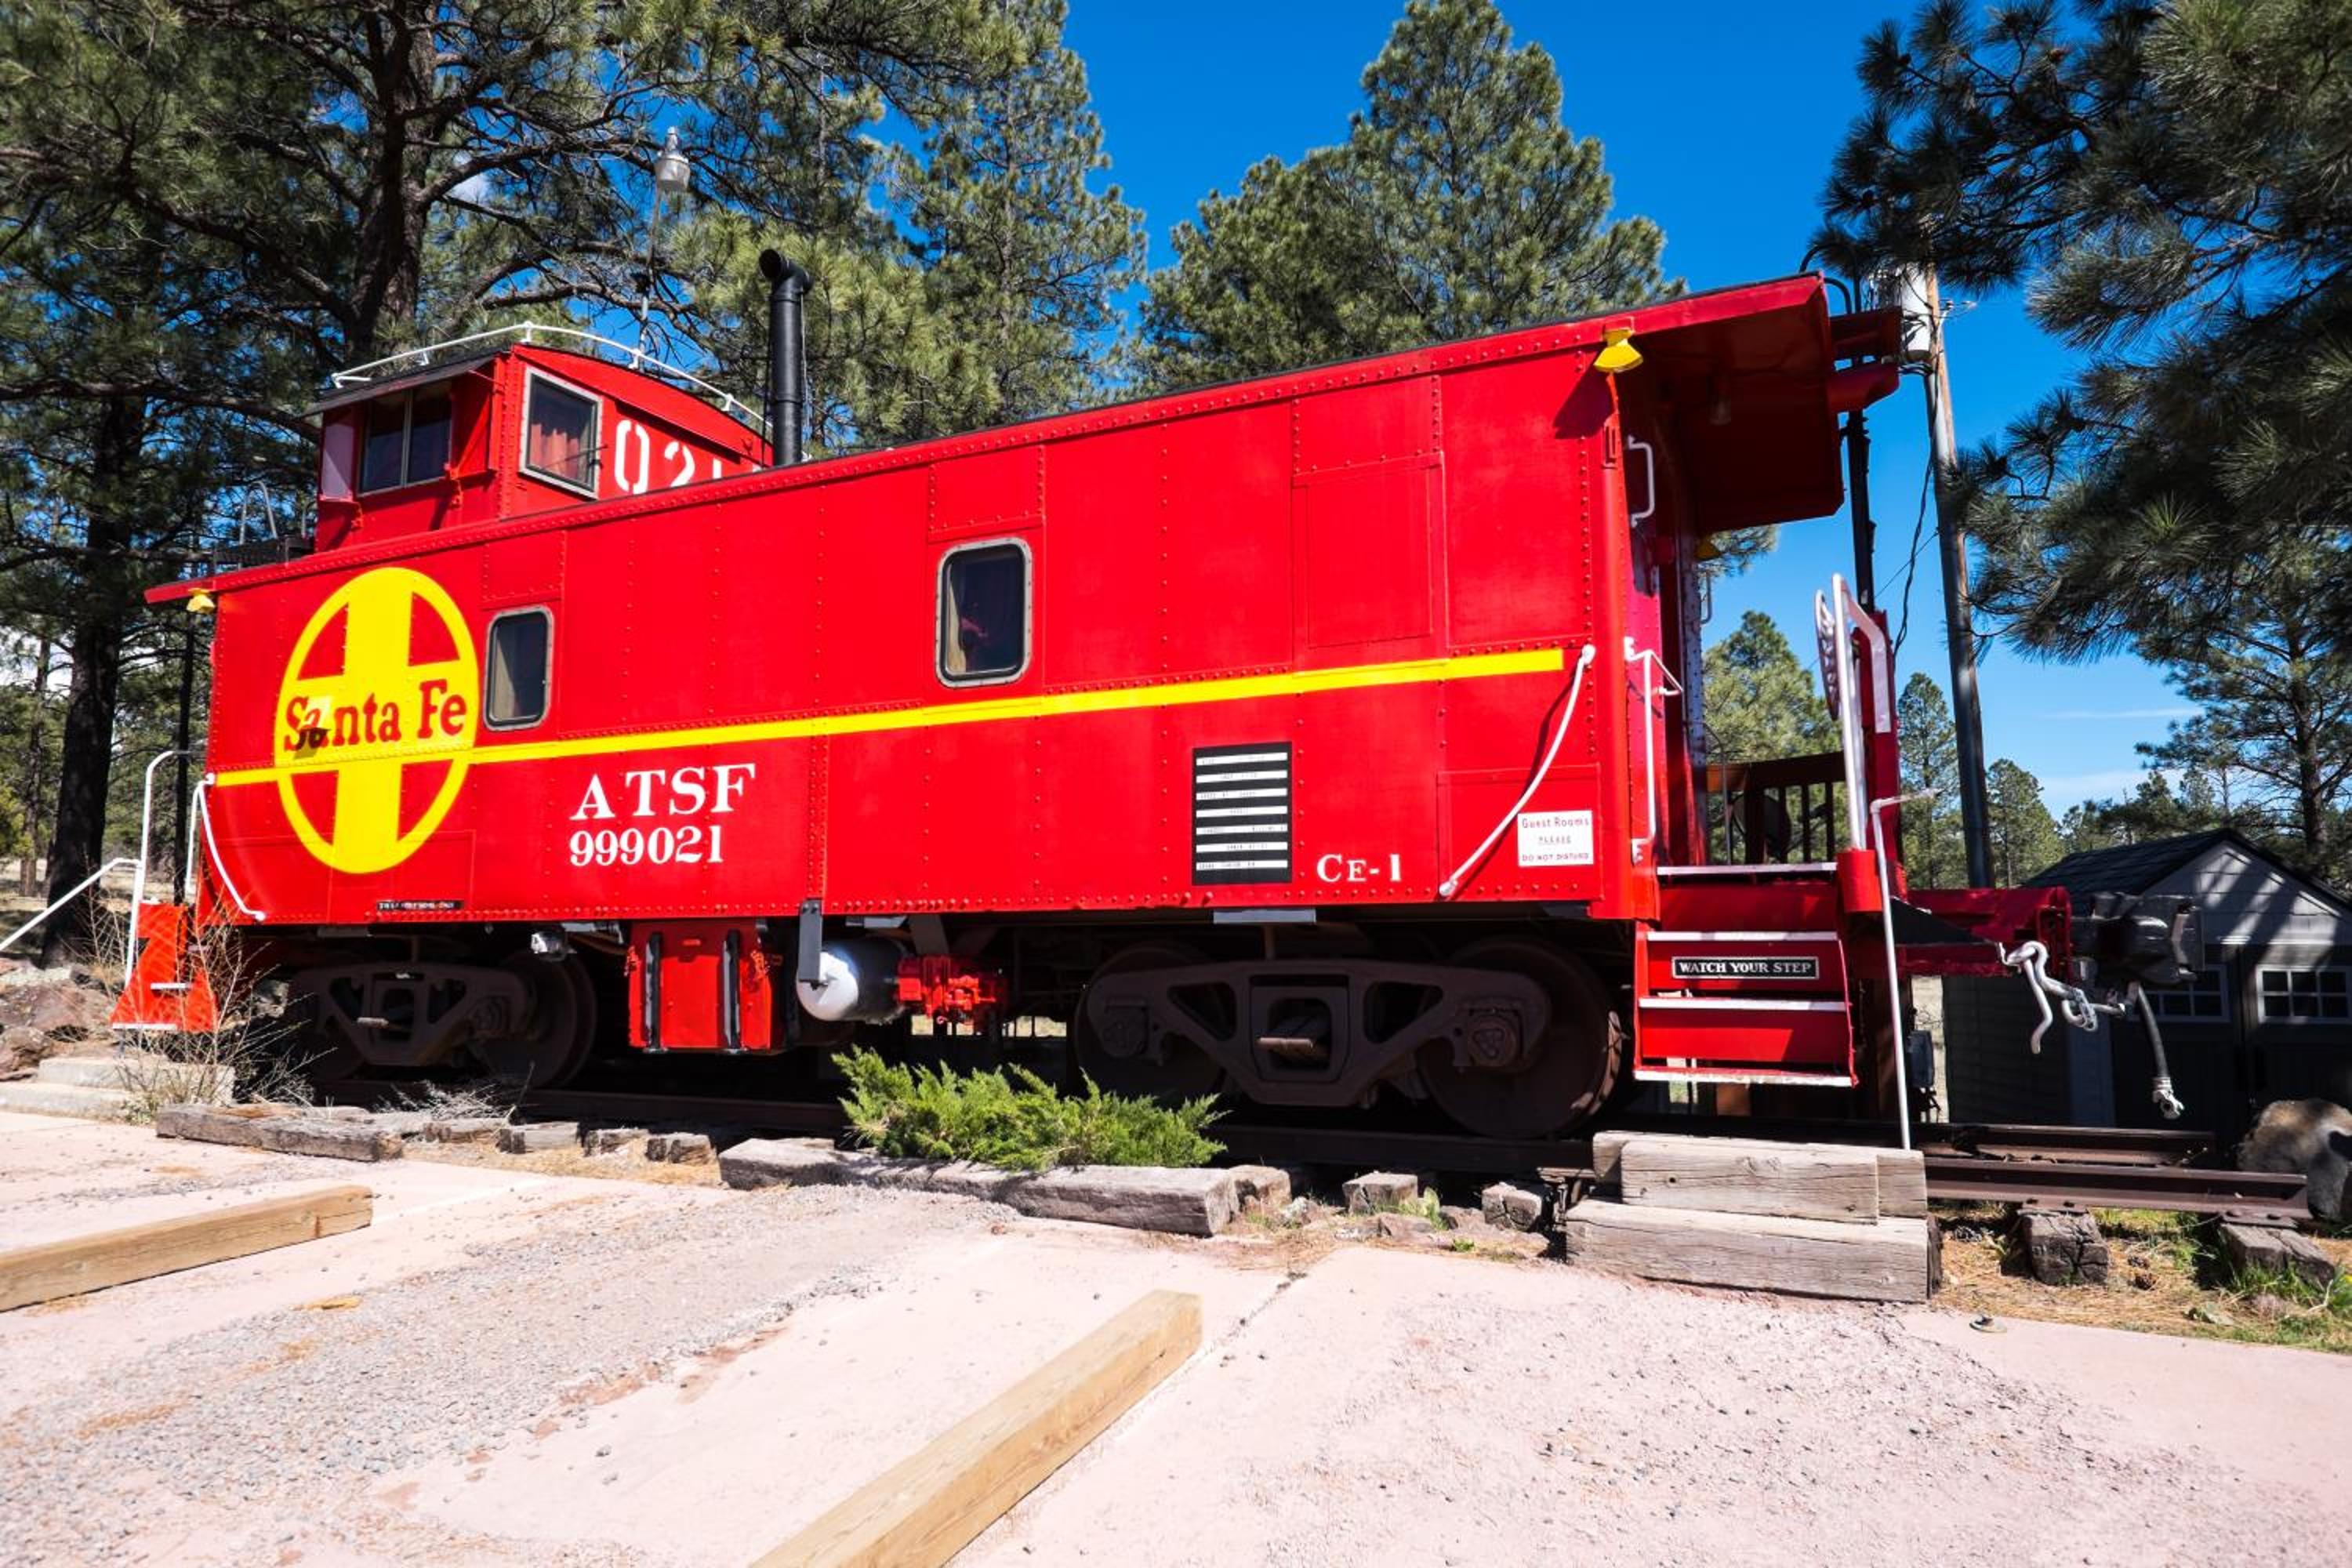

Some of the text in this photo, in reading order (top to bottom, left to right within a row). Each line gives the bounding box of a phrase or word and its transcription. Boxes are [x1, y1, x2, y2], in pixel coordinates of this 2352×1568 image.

[285, 679, 467, 751] Santa Fe
[569, 764, 756, 821] ATSF
[1522, 816, 1589, 829] Guest Rooms
[569, 826, 724, 866] 999021
[1679, 961, 1811, 973] WATCH YOUR STEP
